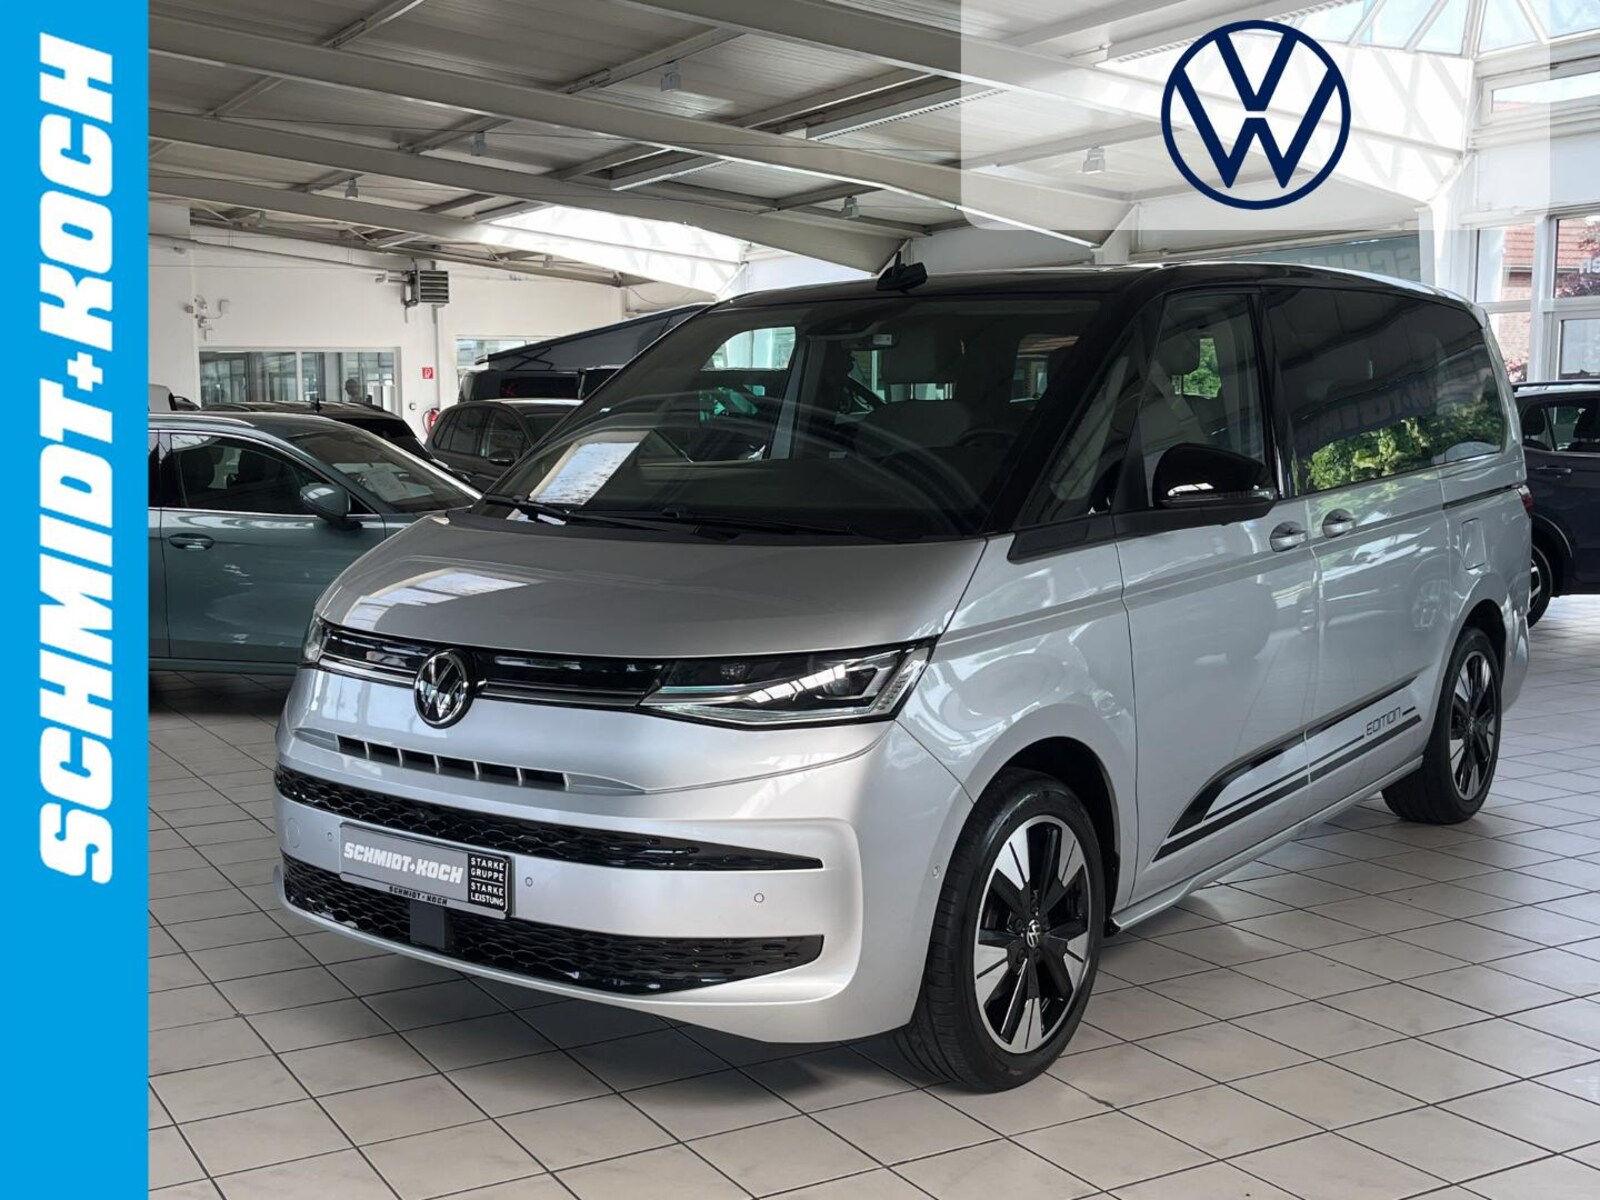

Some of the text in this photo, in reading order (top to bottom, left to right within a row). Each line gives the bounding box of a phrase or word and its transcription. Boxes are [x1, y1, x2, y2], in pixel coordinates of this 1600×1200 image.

[1366, 706, 1401, 737] EDITION
[343, 842, 464, 884] SCHMIDT+KOCH
[471, 857, 504, 871] STARKE
[471, 867, 504, 882] GRUPPE
[471, 881, 504, 896] STARKE
[471, 892, 504, 907] LEISTUNG
